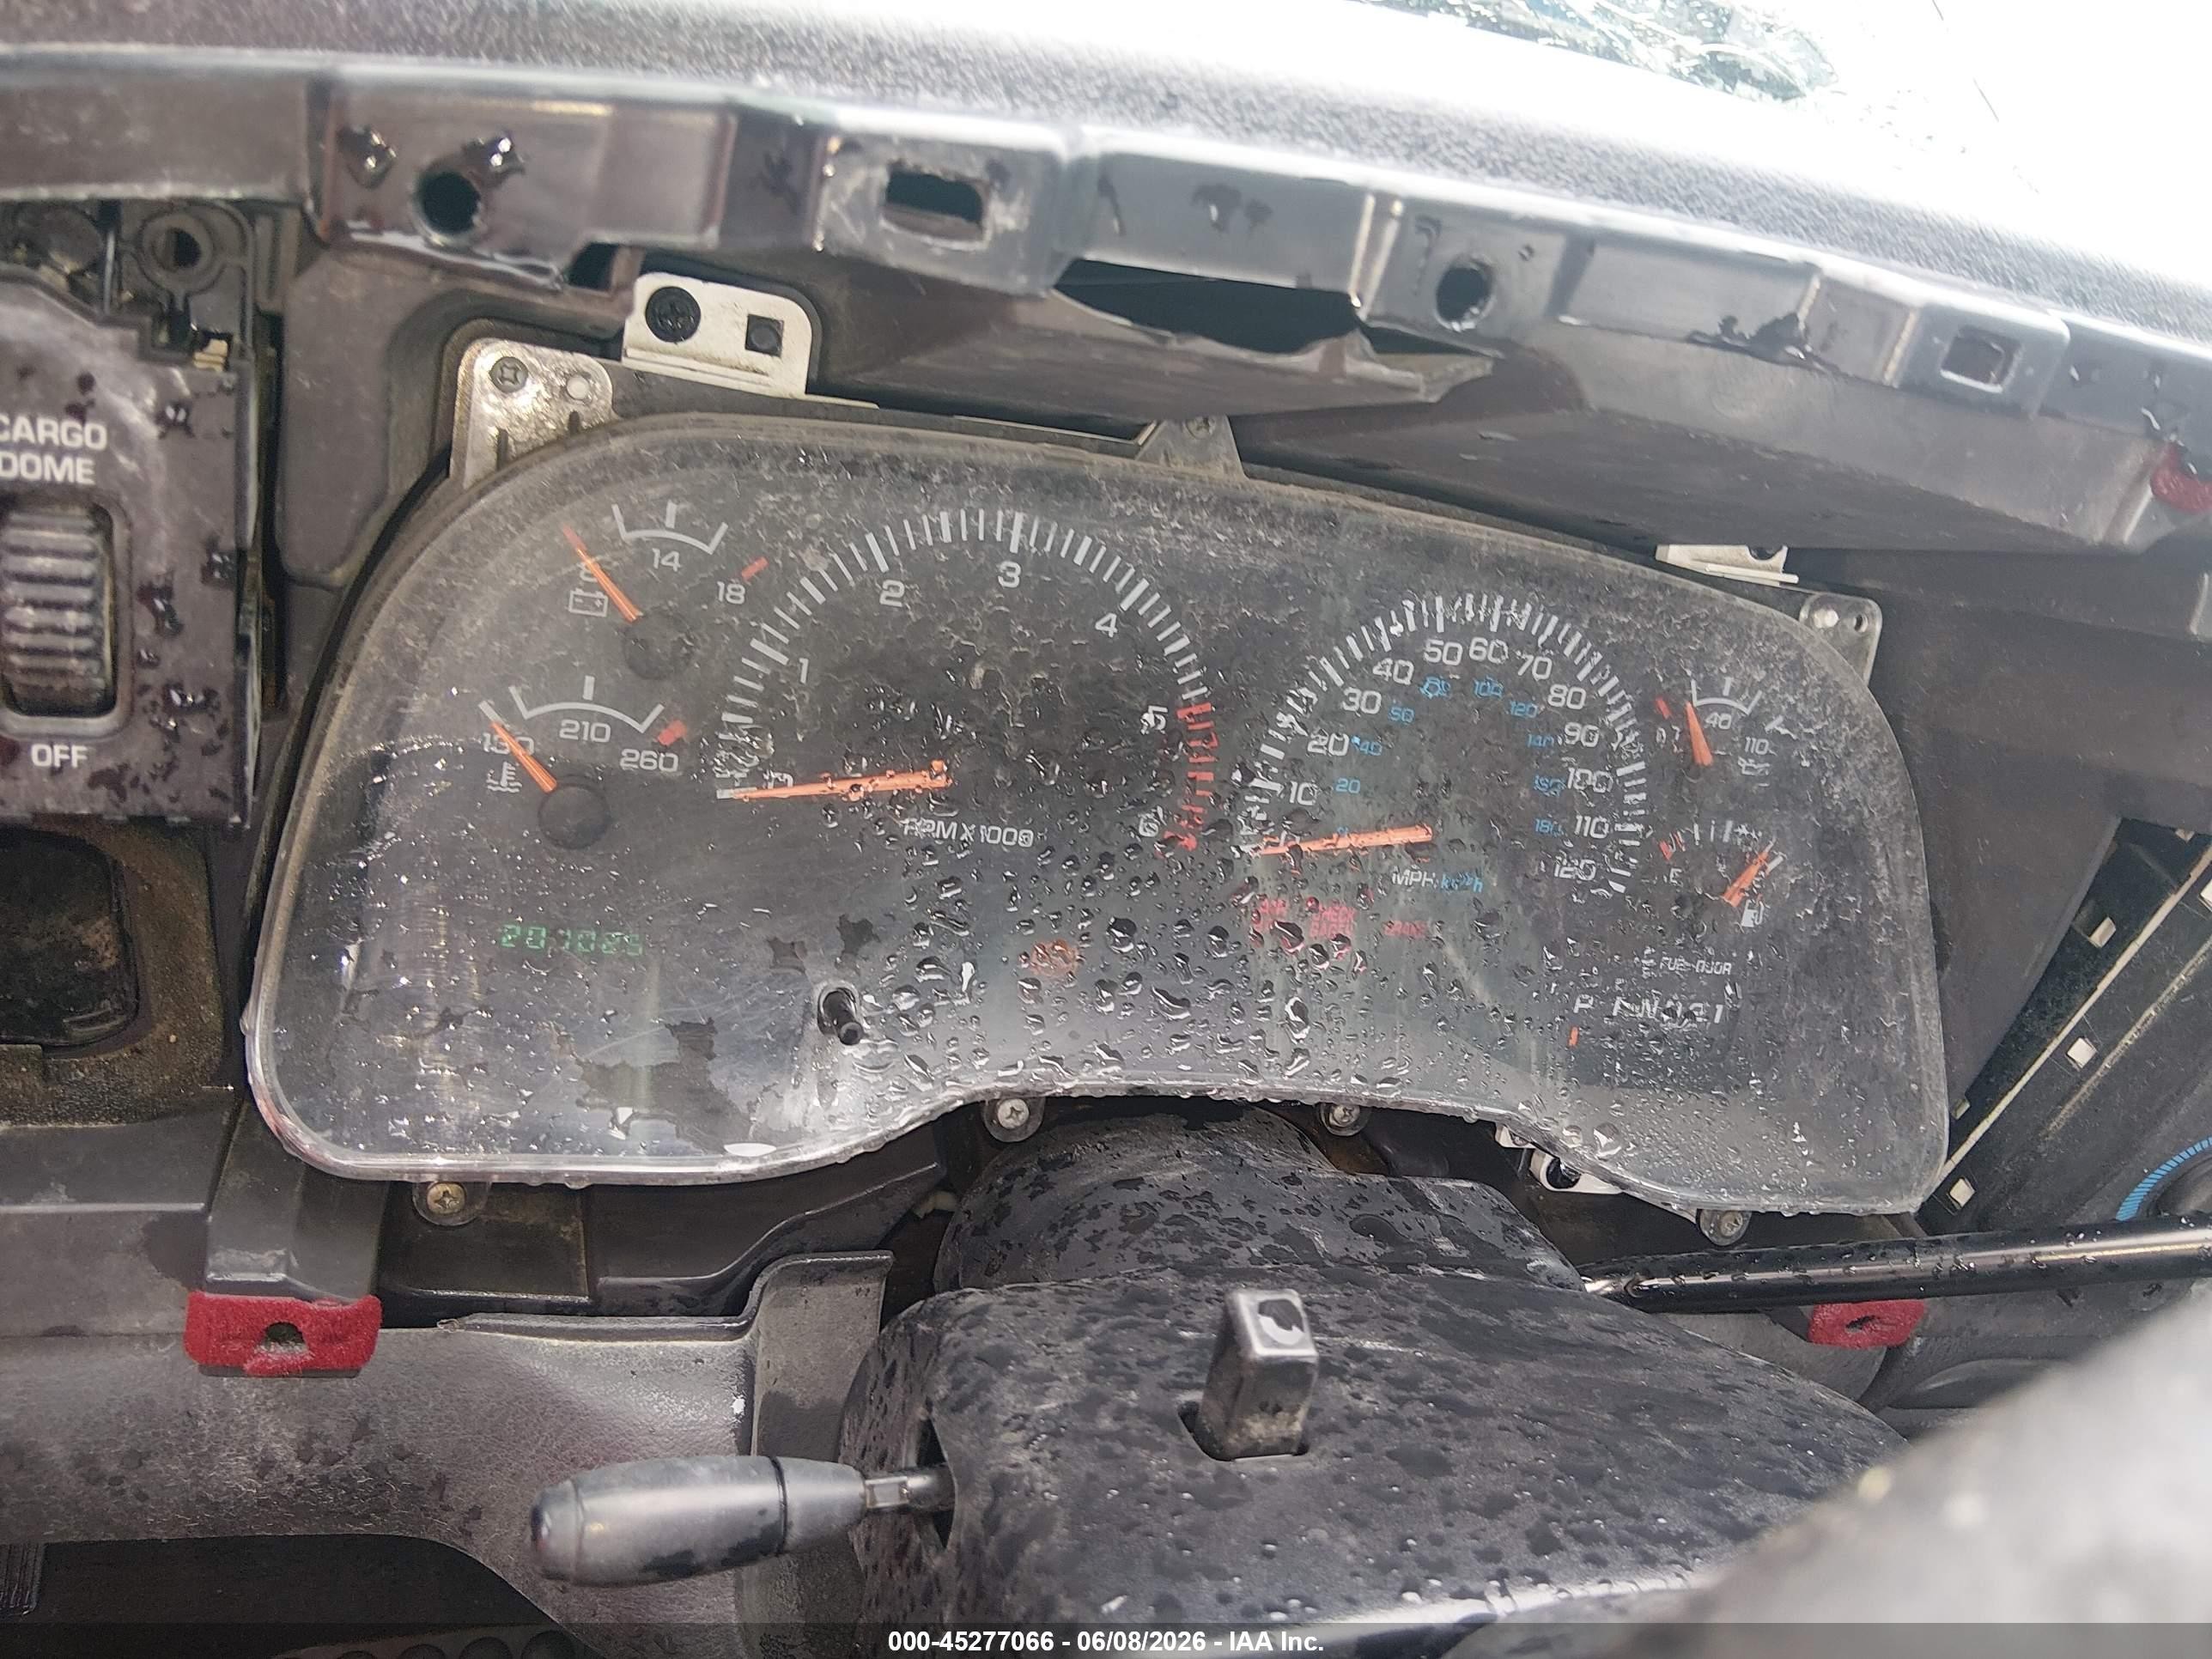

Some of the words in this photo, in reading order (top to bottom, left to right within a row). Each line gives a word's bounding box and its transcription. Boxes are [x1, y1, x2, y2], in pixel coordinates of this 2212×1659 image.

[0, 451, 96, 485] DOME
[653, 548, 681, 572] 14
[997, 561, 1022, 588] 3
[716, 581, 746, 605] 18
[879, 580, 905, 607] 2
[1095, 612, 1118, 637] 4
[1423, 638, 1463, 666] 50
[1468, 636, 1510, 665] 60
[797, 657, 810, 684] 1
[1373, 657, 1414, 684] 40
[1516, 654, 1553, 682] 70
[1342, 687, 1382, 715] 30
[1547, 684, 1587, 710] 80
[1510, 701, 1539, 719] 120
[1705, 712, 1732, 730] 40
[559, 720, 611, 744] 210
[1307, 730, 1349, 757] 20
[1564, 722, 1600, 748] 90
[31, 744, 88, 769] OFF
[1359, 740, 1382, 756] 40
[1744, 737, 1769, 755] 110
[619, 749, 678, 772] 260
[1335, 777, 1361, 793] 20
[1566, 767, 1613, 793] 100
[1289, 781, 1317, 806] 10
[1573, 815, 1610, 840] 110
